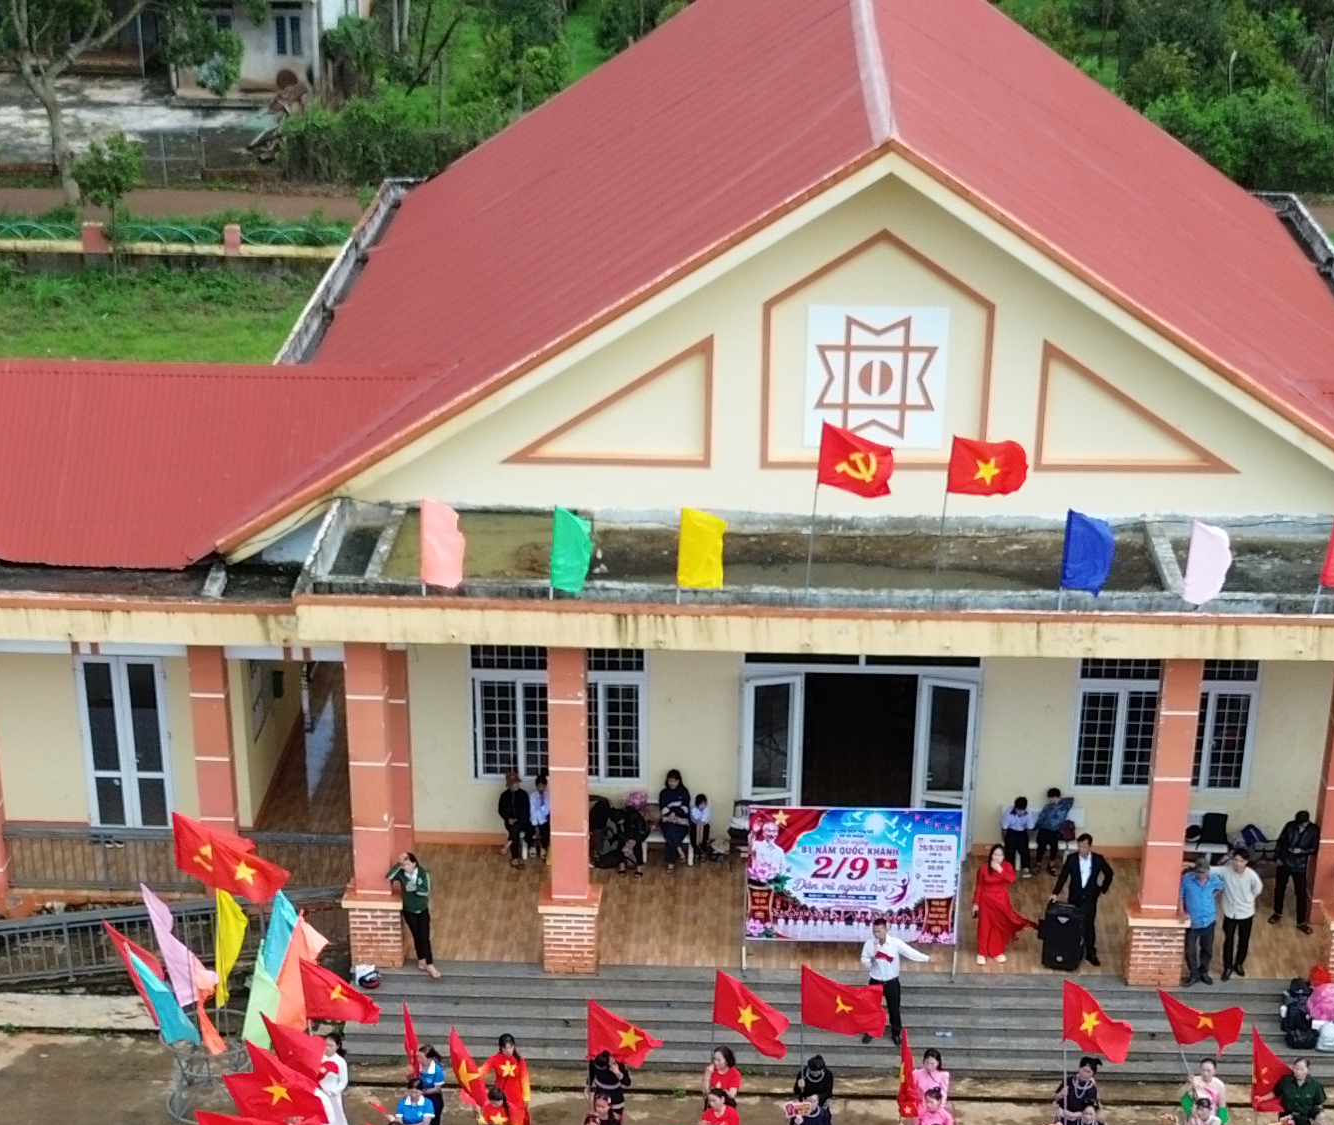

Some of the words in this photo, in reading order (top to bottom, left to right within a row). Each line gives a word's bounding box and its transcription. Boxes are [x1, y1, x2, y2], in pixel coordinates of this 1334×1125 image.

[815, 846, 836, 855] NĂM
[839, 846, 864, 856] QUỐC
[867, 847, 900, 856] KHÁNH
[810, 856, 870, 880] 2/9
[792, 878, 818, 892] Dân
[837, 882, 867, 895] ngoài
